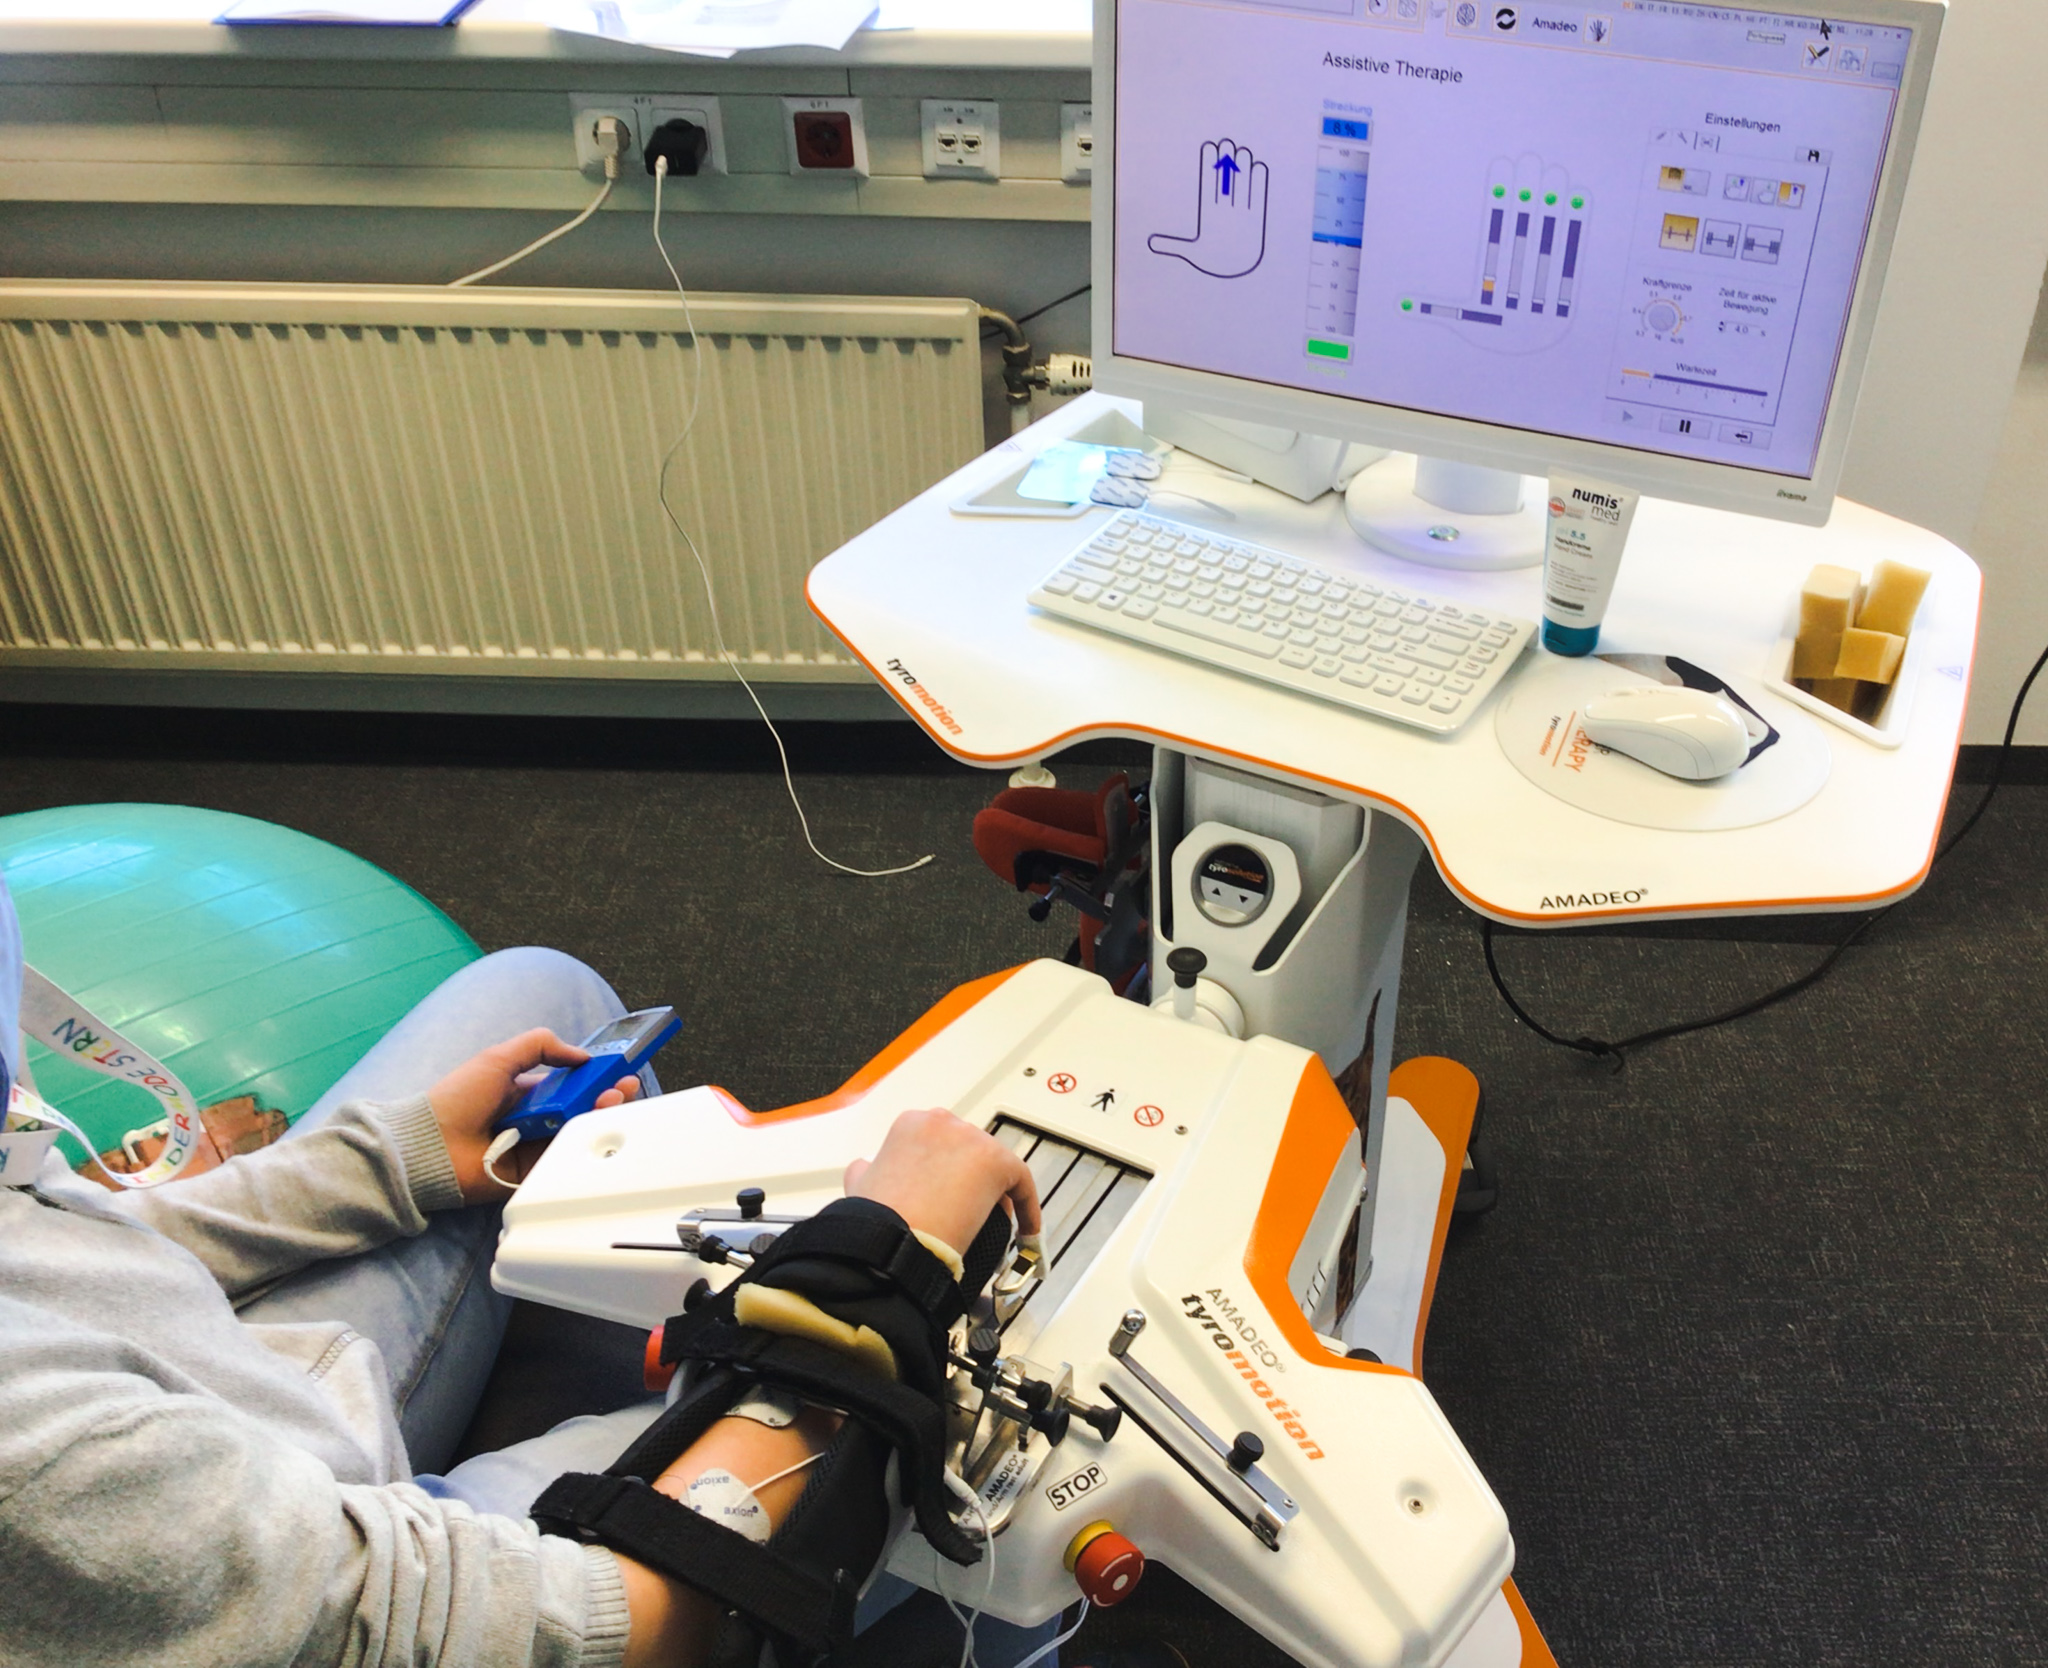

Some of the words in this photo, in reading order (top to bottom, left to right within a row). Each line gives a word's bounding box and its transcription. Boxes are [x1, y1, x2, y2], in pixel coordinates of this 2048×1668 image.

[1532, 17, 1577, 33] Amadeo
[1322, 51, 1390, 74] Assistive
[1395, 60, 1463, 84] Therapie
[1705, 112, 1781, 133] Einstellungen
[1572, 488, 1618, 510] numis
[1591, 504, 1621, 522] med
[886, 658, 964, 736] tyromotion
[1564, 726, 1593, 772] ERAPY
[1181, 1293, 1326, 1461] tyromotion
[695, 1475, 730, 1486] axion
[1050, 1466, 1100, 1506] STOP
[724, 1505, 754, 1518] axion
